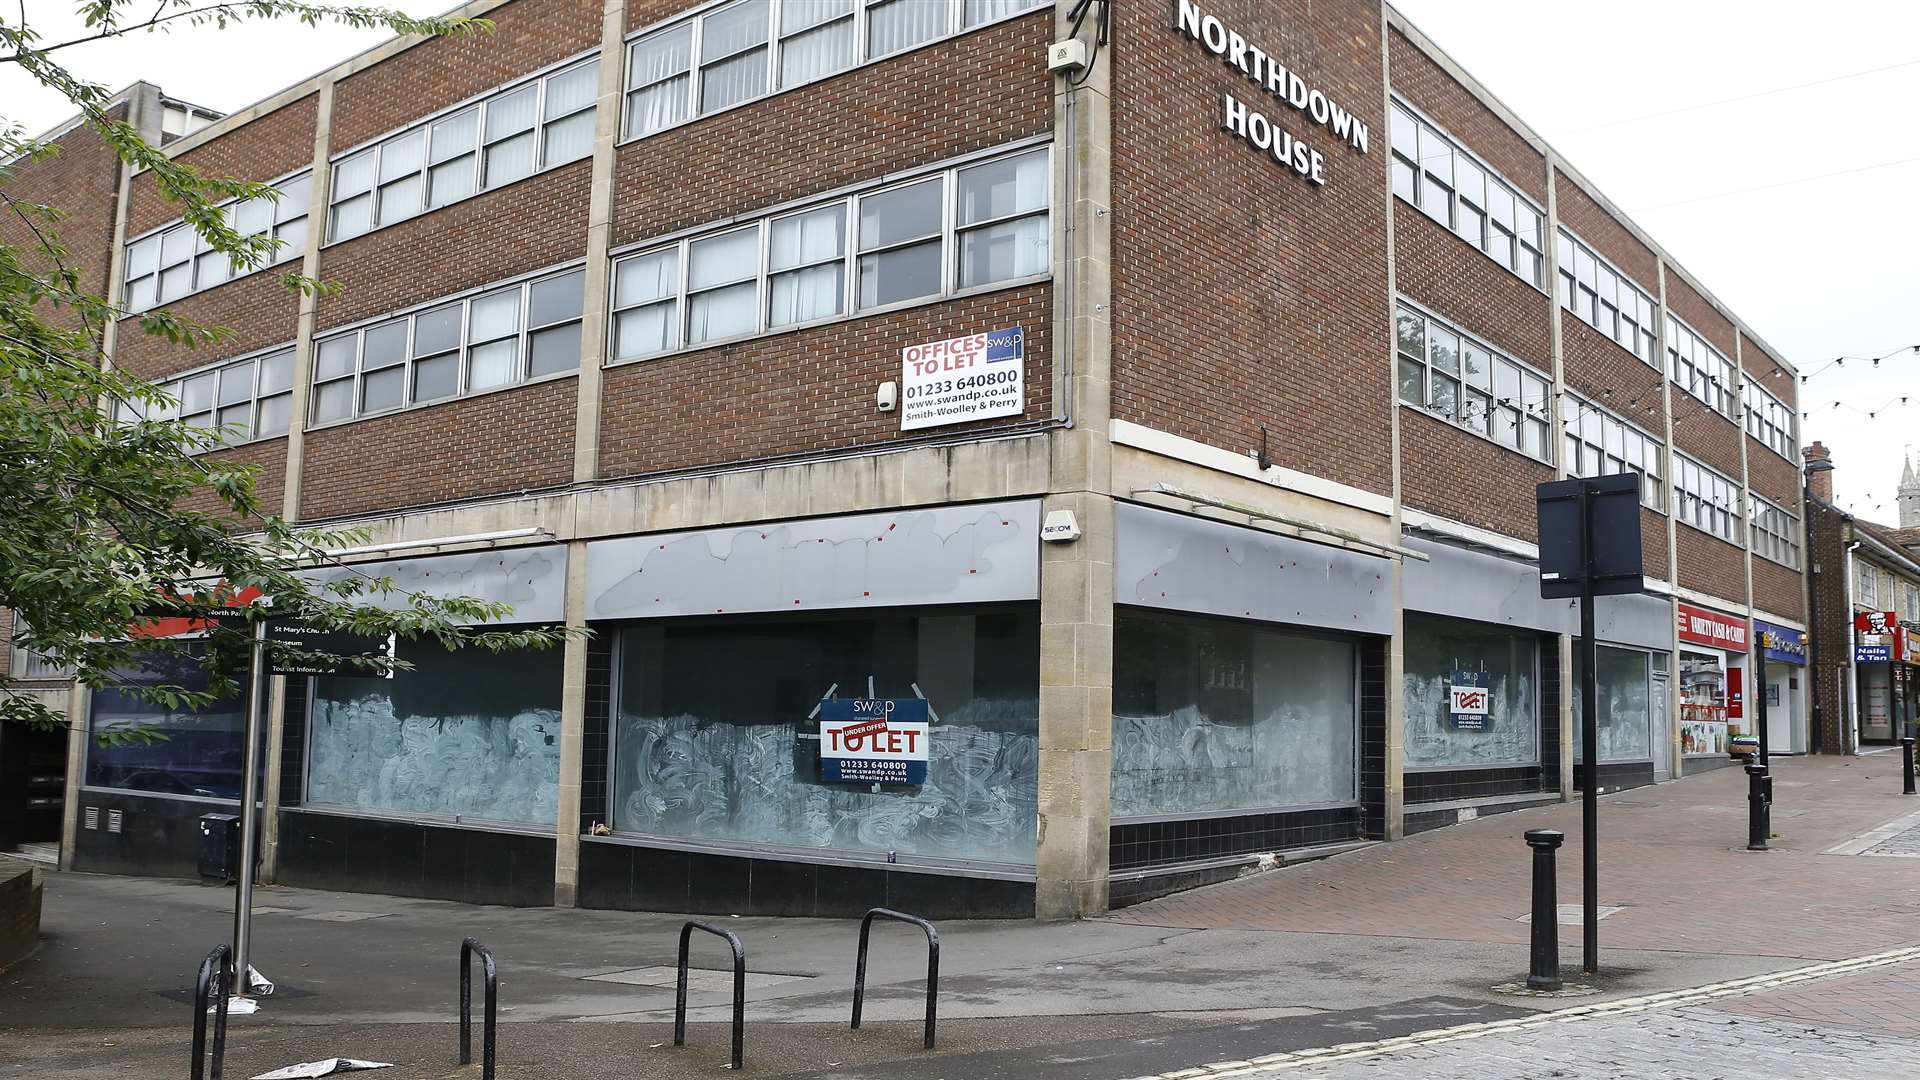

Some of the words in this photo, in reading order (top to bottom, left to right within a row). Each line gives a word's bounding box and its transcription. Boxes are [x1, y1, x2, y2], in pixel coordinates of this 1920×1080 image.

[1176, 0, 1368, 154] NORTHDOWN
[1224, 94, 1325, 186] HOUSE
[906, 335, 986, 362] OFFICES
[913, 359, 939, 376] TO
[943, 352, 978, 371] LET
[907, 380, 952, 399] 01233
[956, 370, 1018, 390] 640800
[907, 384, 1017, 410] www.swandp.co.uk
[906, 403, 977, 421] Smith-Woolley
[979, 401, 987, 410] &
[989, 398, 1018, 409] Perry
[283, 626, 305, 634] Mary's
[1712, 621, 1725, 640] CASH
[827, 729, 864, 752] TO
[872, 730, 921, 753] LET
[844, 727, 866, 737] UNDER
[866, 722, 887, 732] OFFER
[840, 760, 868, 769] 01233
[871, 761, 907, 769] 640800
[840, 768, 907, 776] www.swandp.co.uk
[841, 774, 884, 782] Smith-Woolley
